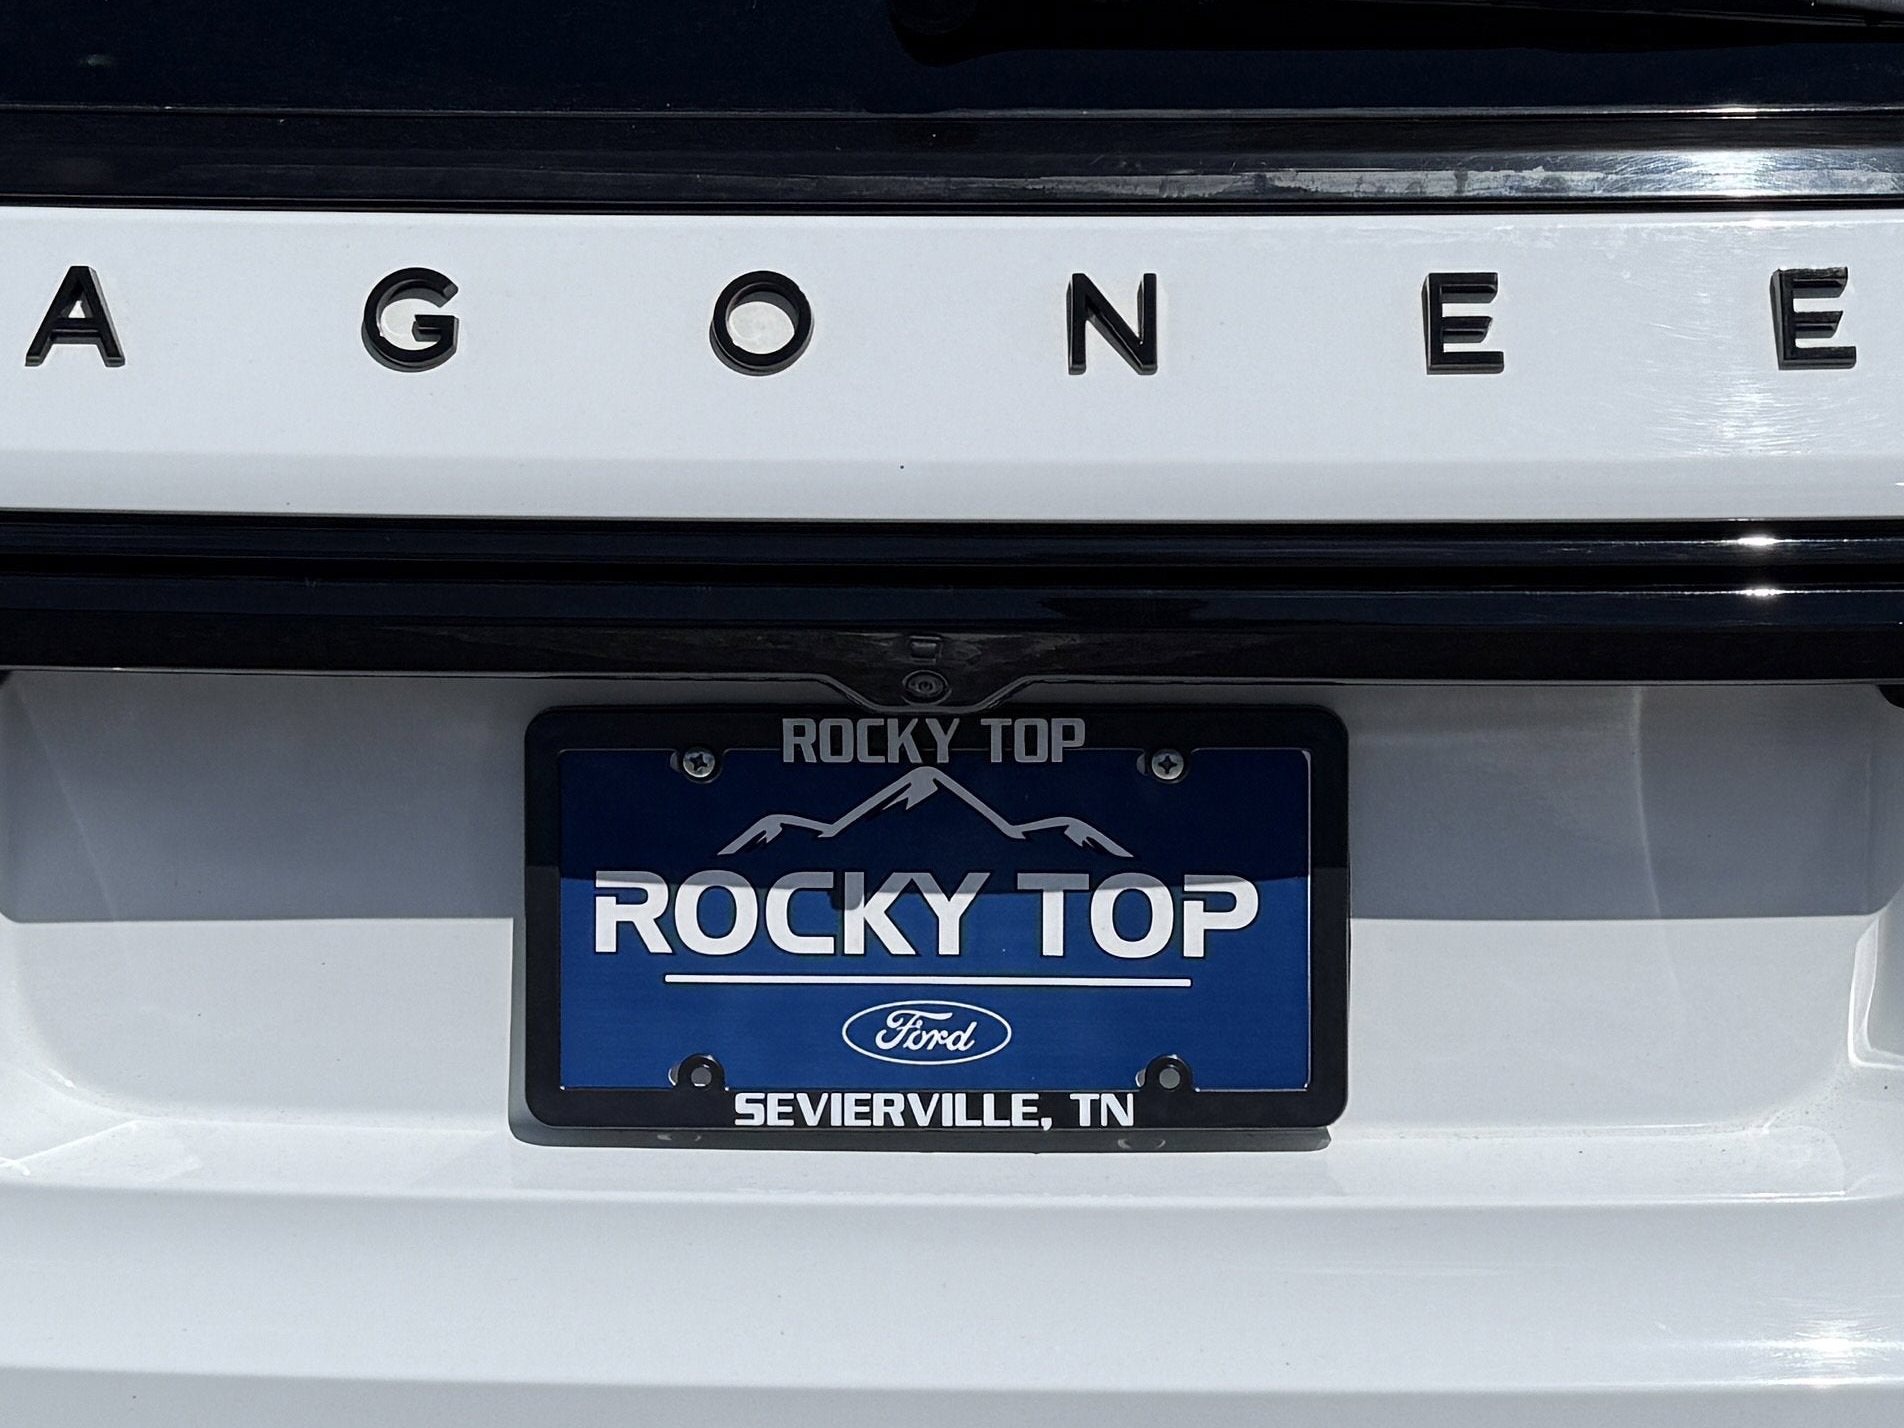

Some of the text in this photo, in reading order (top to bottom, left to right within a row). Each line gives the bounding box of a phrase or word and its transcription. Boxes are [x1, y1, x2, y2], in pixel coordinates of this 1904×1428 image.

[782, 718, 1086, 763] ROCKY TOP
[594, 870, 1259, 958] ROCKY TOP
[875, 1007, 978, 1054] Ford
[734, 1093, 1135, 1131] SEVIERVILLE, TN
